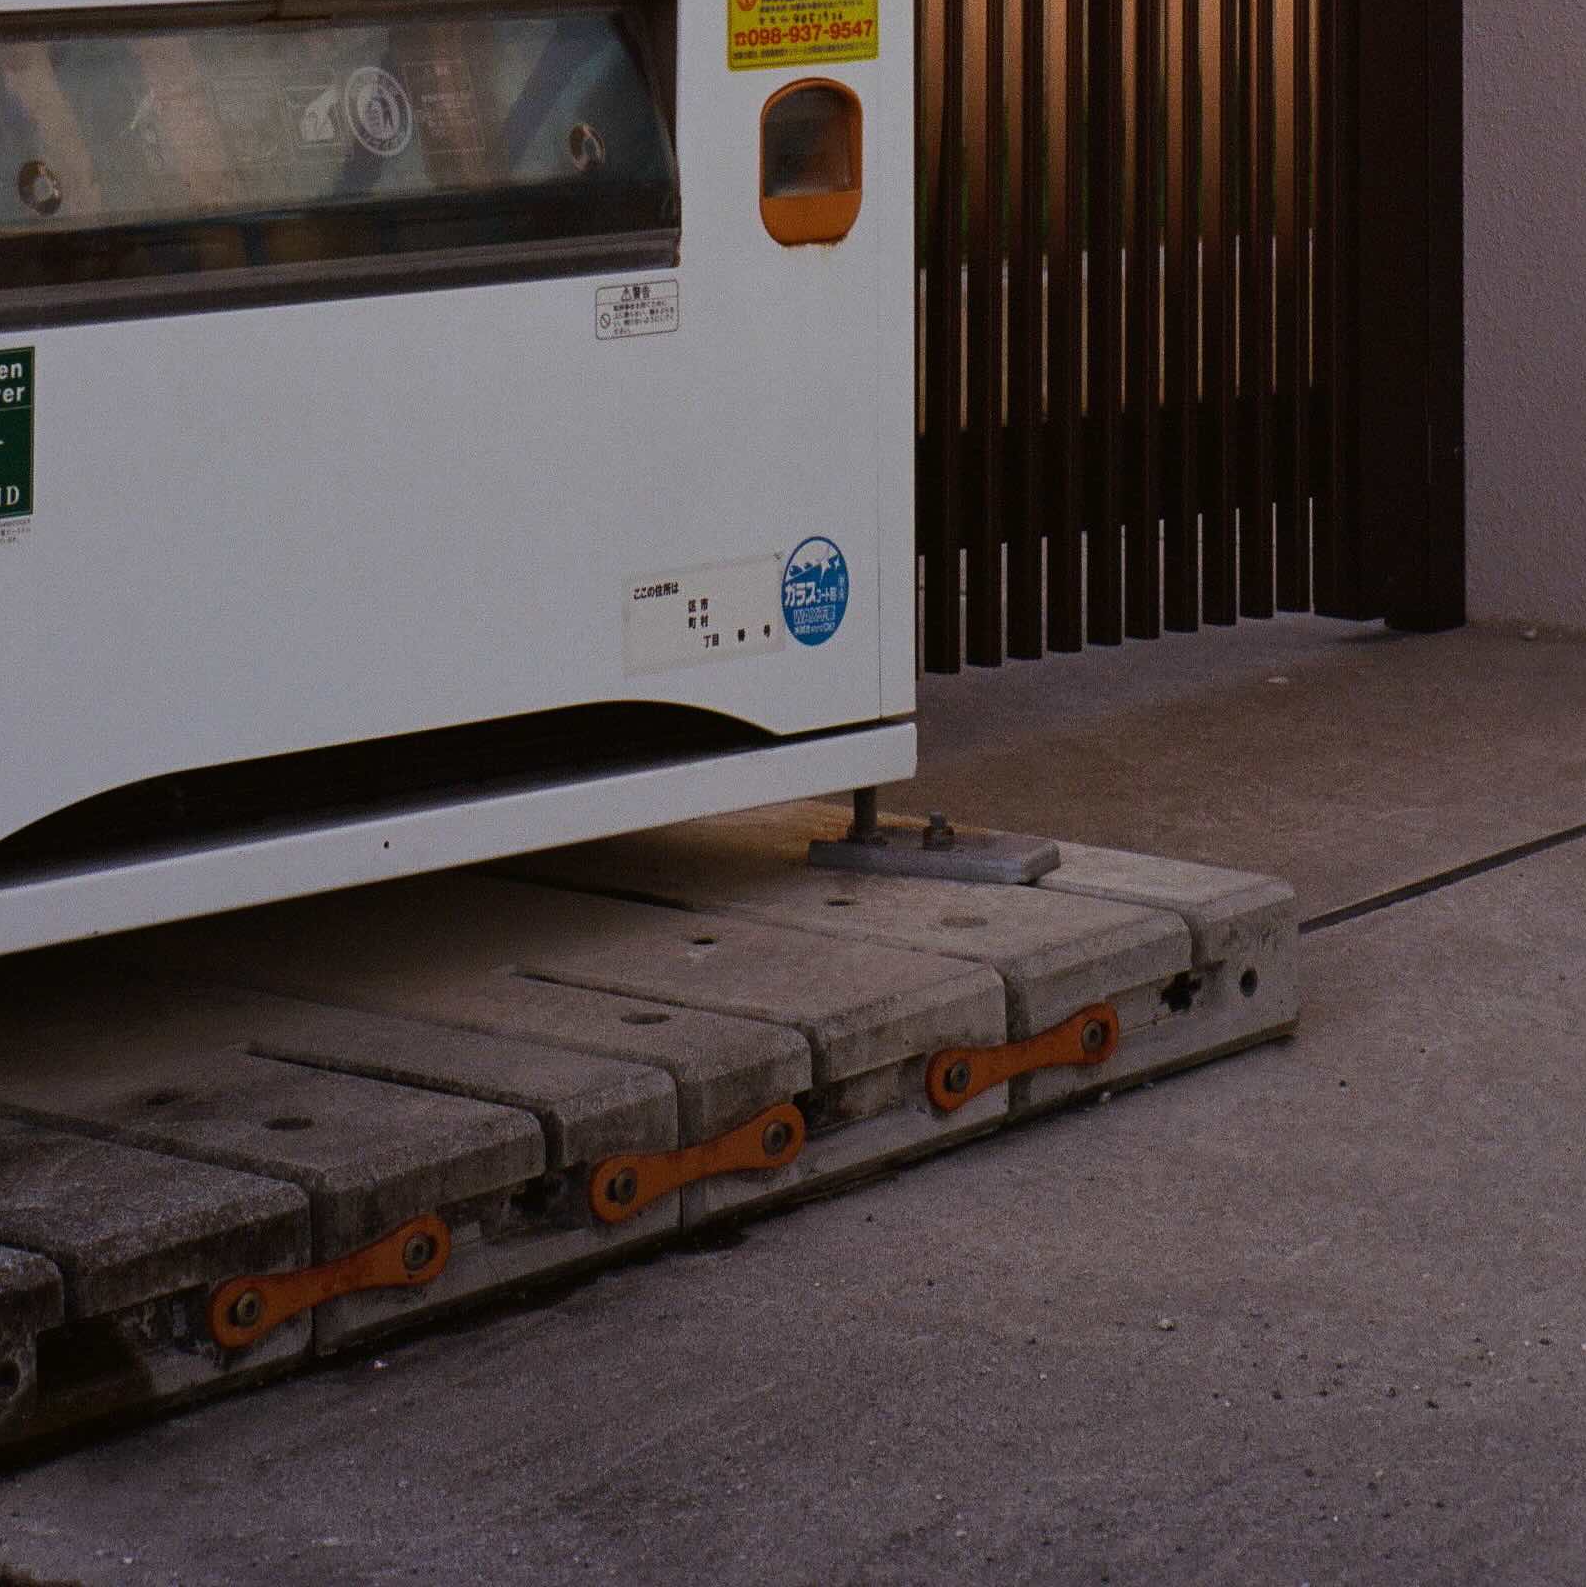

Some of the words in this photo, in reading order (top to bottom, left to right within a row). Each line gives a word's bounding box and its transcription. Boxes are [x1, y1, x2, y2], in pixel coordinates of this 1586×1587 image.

[747, 19, 874, 46] 098-937-9547
[633, 582, 679, 600] ここの住所は
